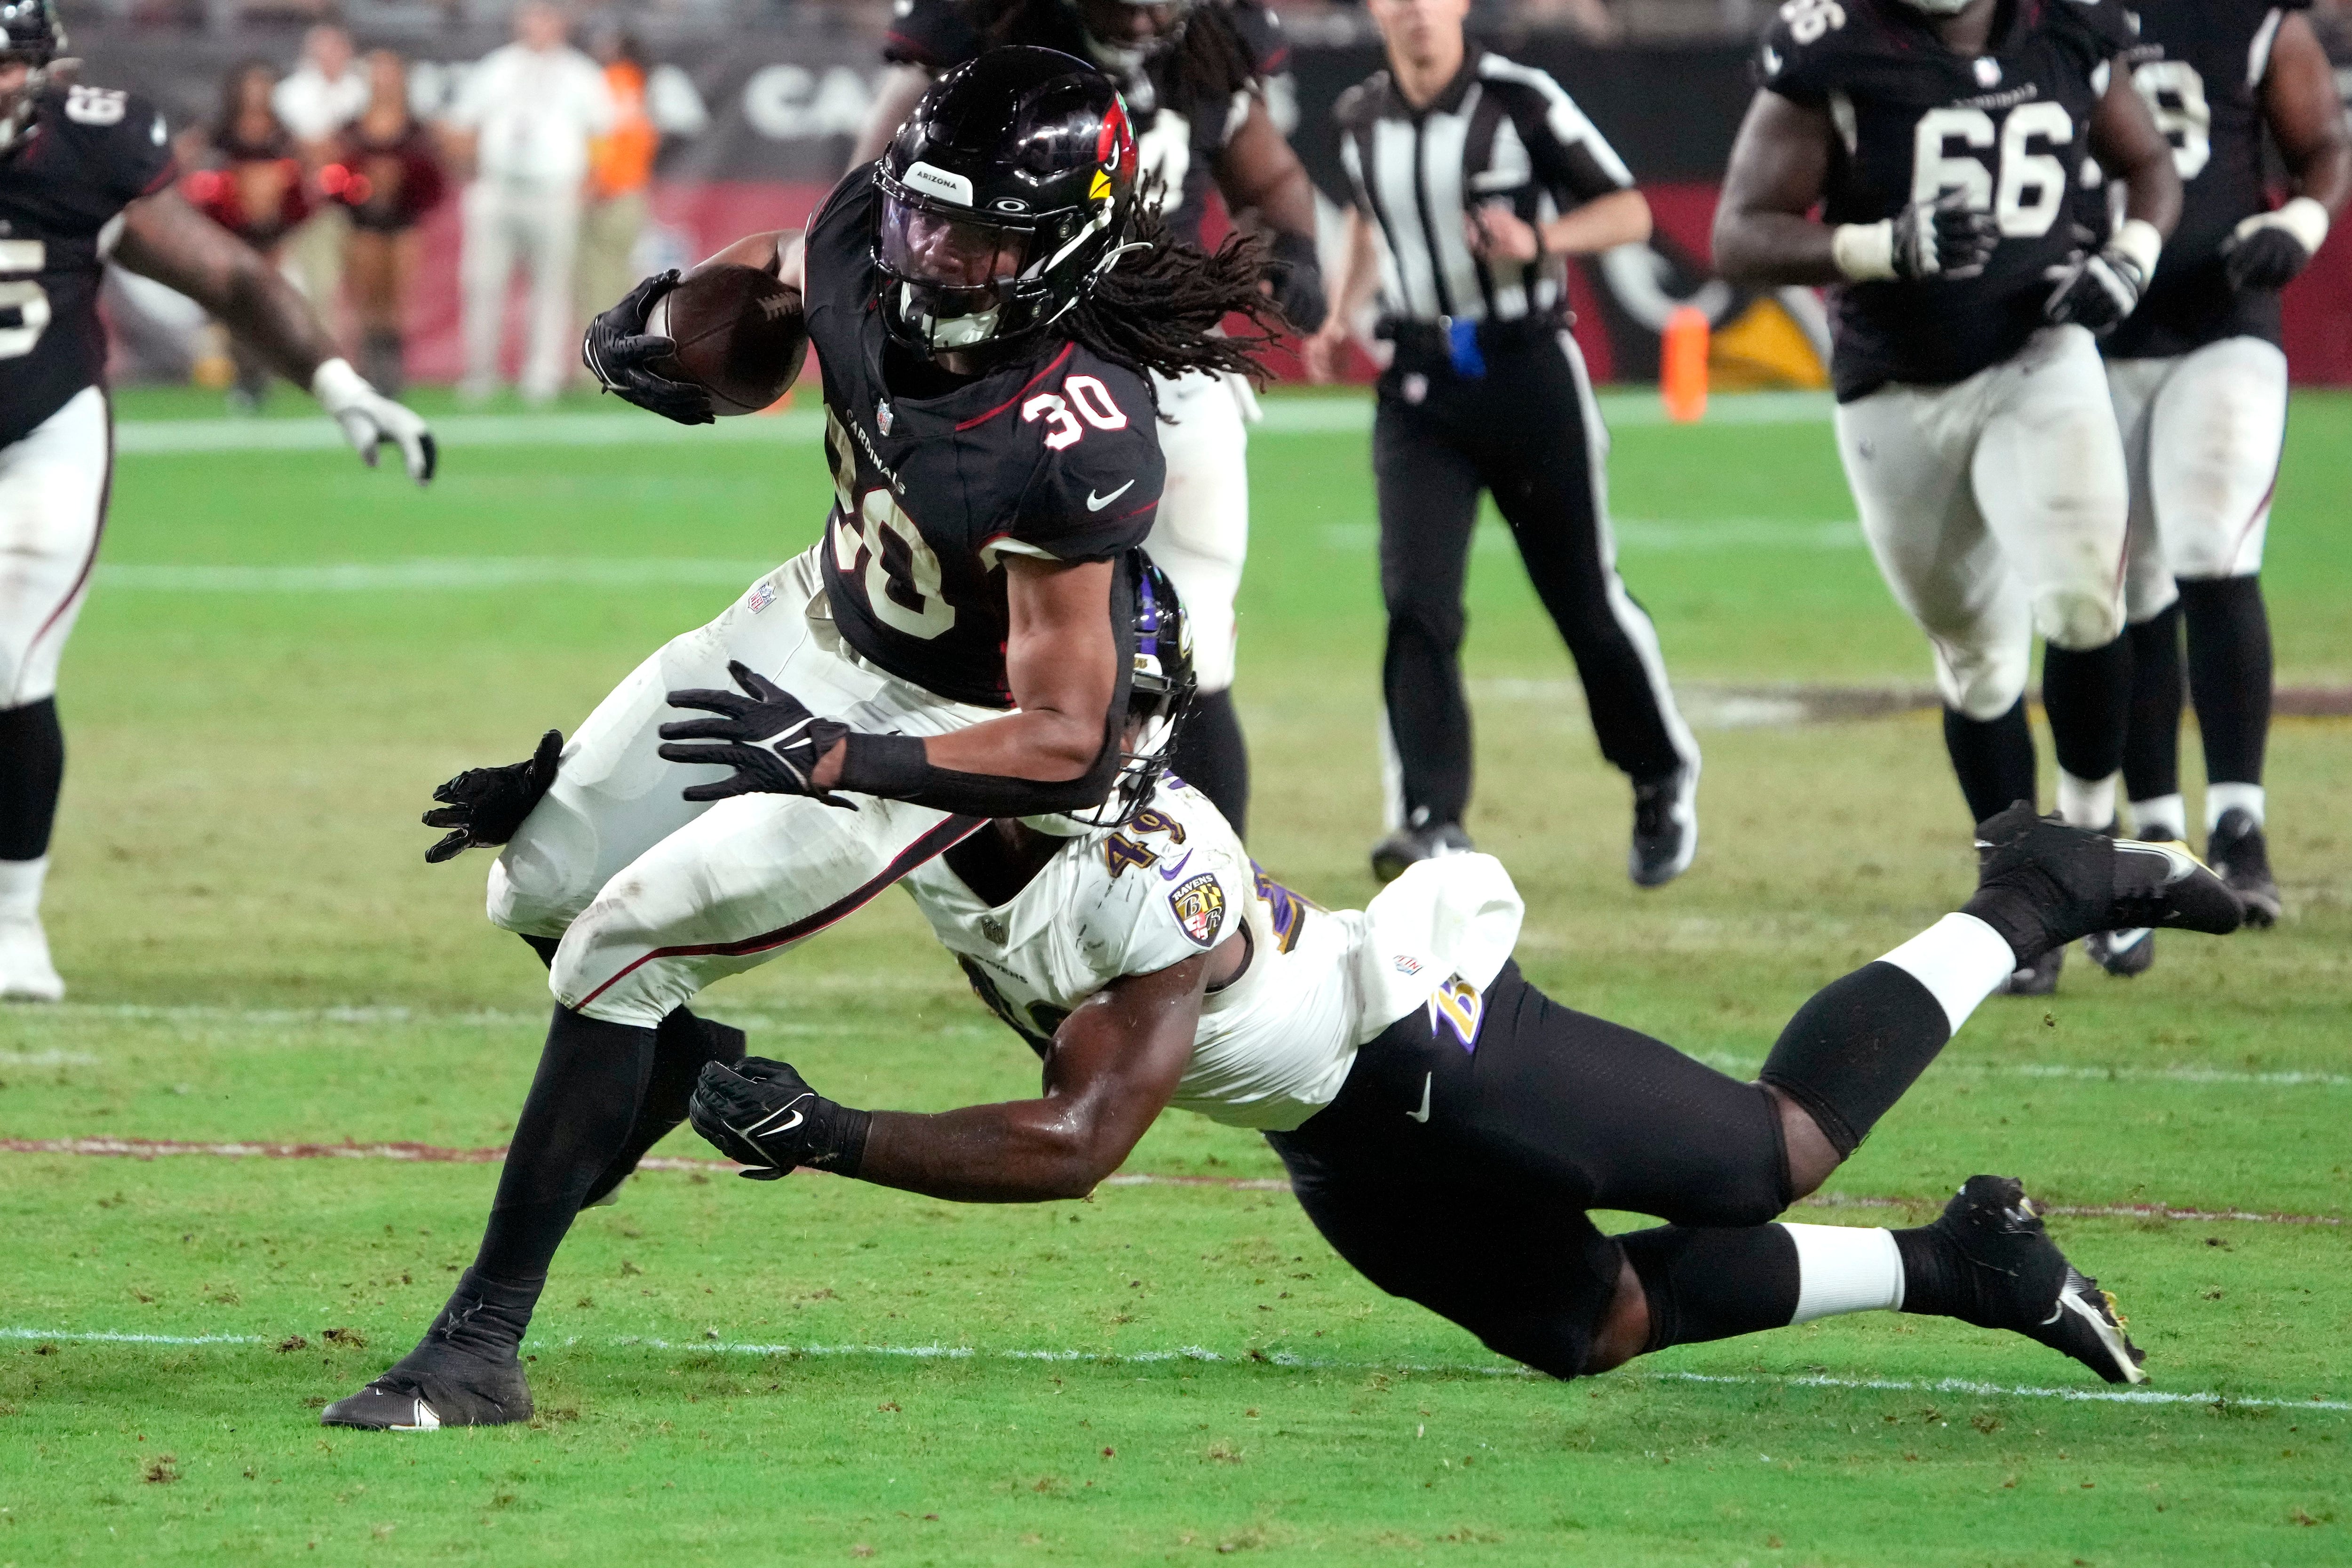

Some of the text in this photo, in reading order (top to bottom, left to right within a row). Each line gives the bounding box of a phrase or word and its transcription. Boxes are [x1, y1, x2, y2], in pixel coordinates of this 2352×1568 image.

[917, 170, 957, 190] ARIZONA
[1913, 101, 2073, 236] 66
[1021, 374, 1130, 452] 30
[847, 408, 906, 495] CARDINALS
[750, 592, 764, 610] NFL
[1104, 808, 1186, 878] 49
[1172, 875, 1213, 901] RAVENS
